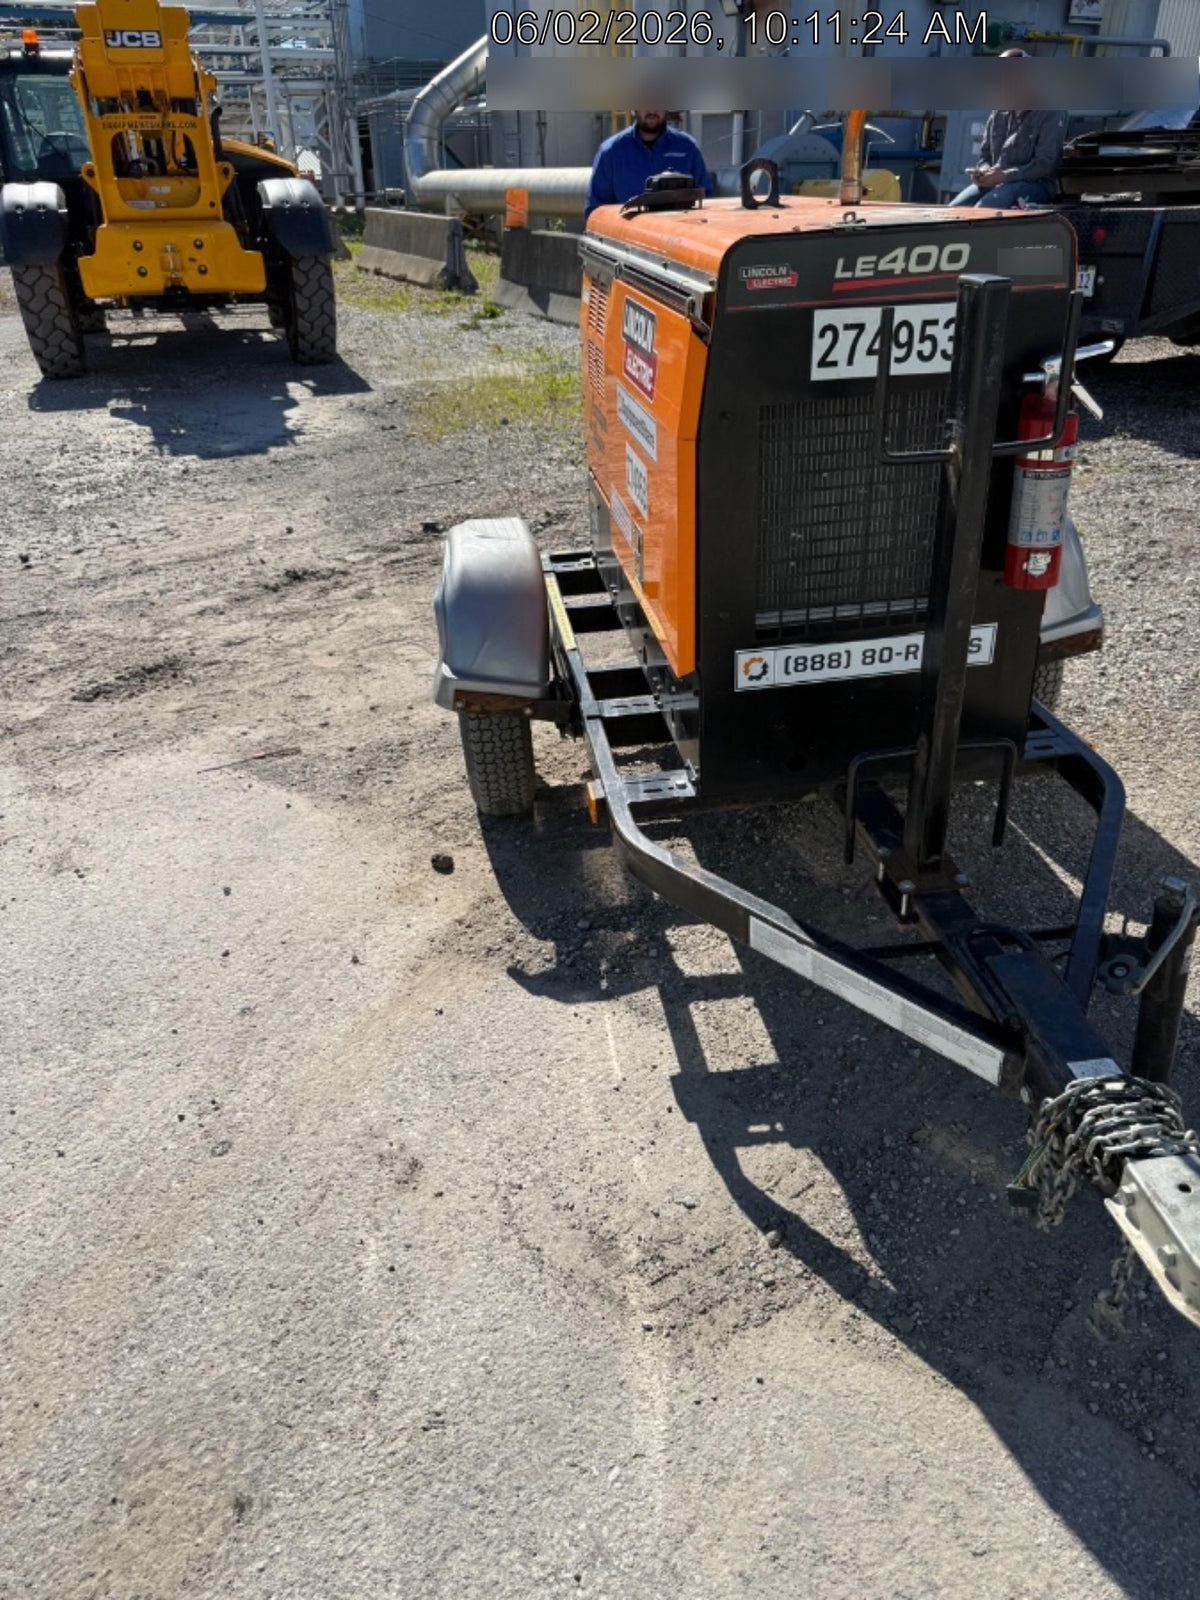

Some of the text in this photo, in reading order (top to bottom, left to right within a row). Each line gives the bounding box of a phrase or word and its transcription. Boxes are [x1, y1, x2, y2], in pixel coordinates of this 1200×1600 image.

[106, 31, 161, 47] JCB
[834, 242, 970, 279] LE400
[742, 266, 788, 278] LINCOLN
[753, 276, 793, 288] ELECTRIC
[623, 303, 653, 354] LINCOLN
[783, 650, 851, 676] (888)
